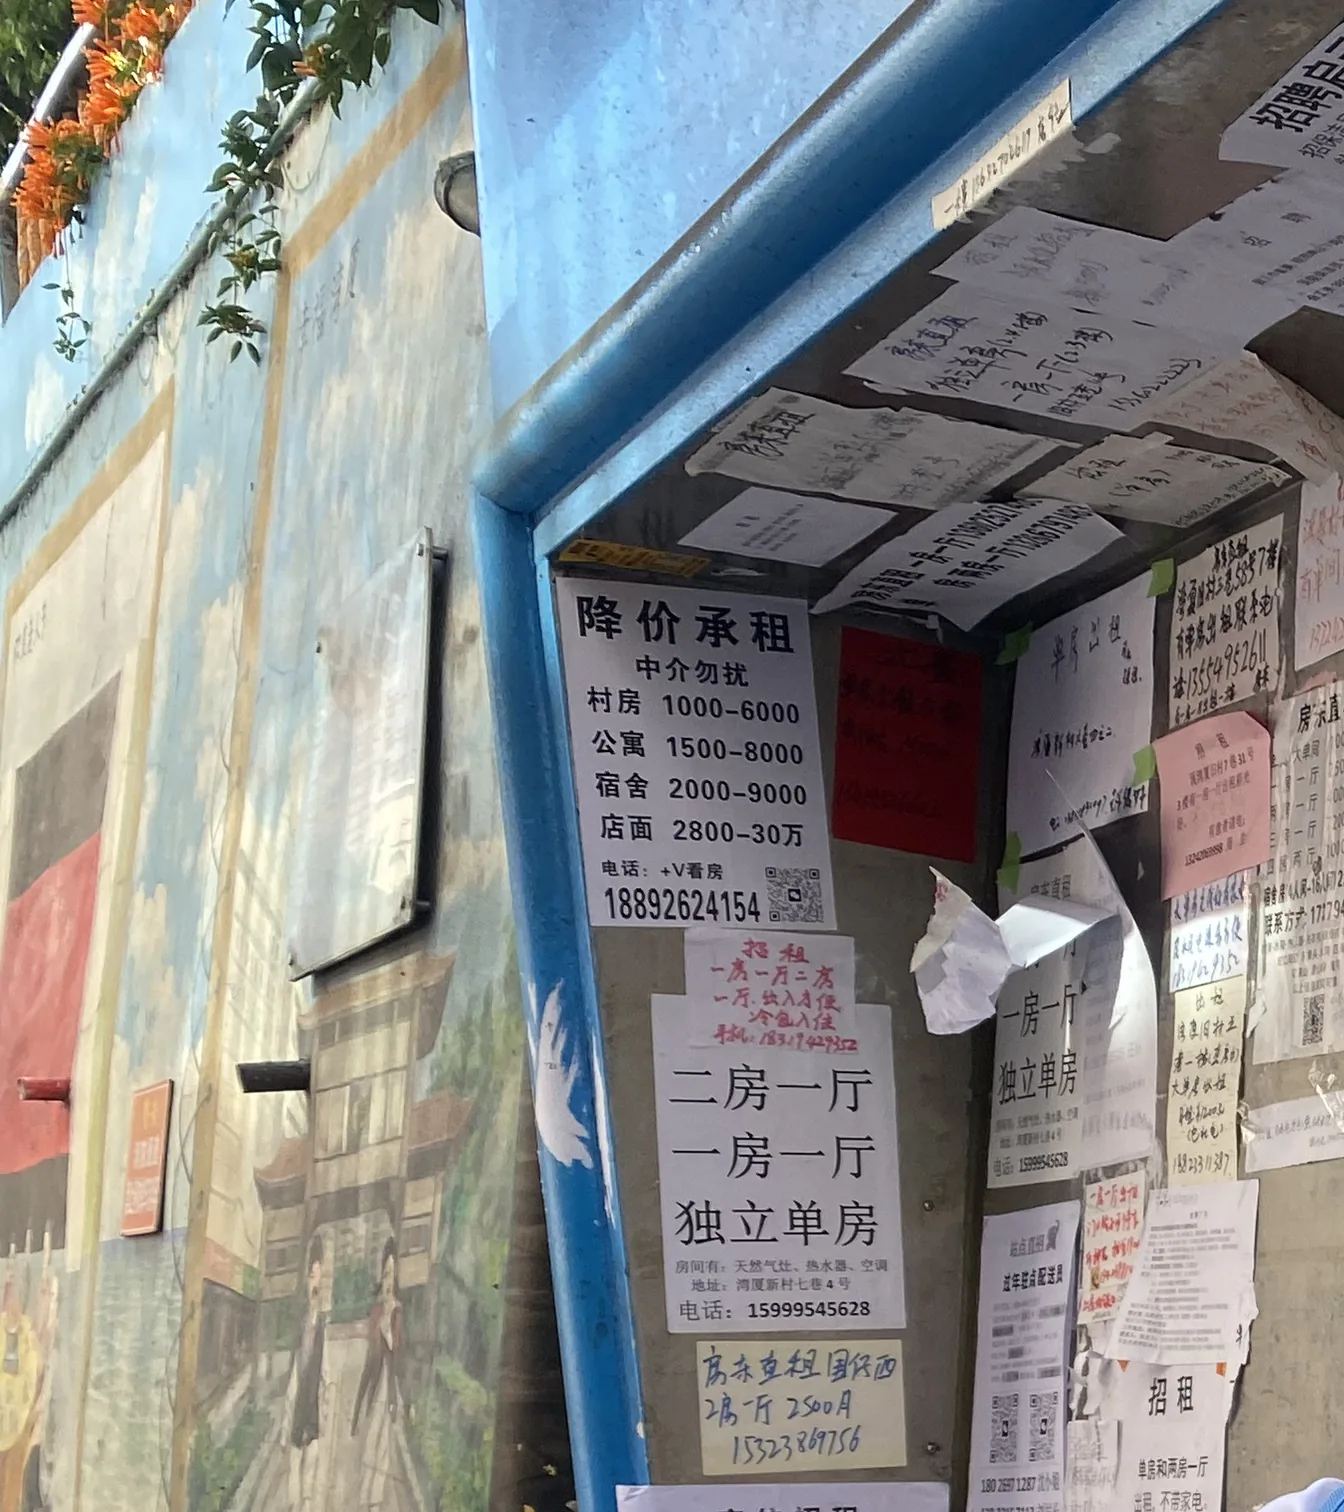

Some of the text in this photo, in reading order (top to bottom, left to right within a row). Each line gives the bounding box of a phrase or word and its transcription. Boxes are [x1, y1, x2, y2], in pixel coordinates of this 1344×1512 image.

[577, 596, 794, 653] 降价承租
[636, 656, 749, 687] 中介勿扰
[588, 688, 799, 724] 村房 1000-6000
[592, 730, 803, 764] 公寓 1500-8000
[596, 772, 806, 805] 宿舍 2000-9000
[600, 814, 803, 847] 店面 2800-30万
[605, 888, 760, 922] 18892624154
[669, 1063, 873, 1113] 二房一厅
[998, 1049, 1079, 1105] 独立单房
[672, 1131, 875, 1179] 一房一厅
[674, 1199, 879, 1246] 独立单房
[1148, 1376, 1194, 1416] 招租
[734, 1425, 861, 1464] 15323869756
